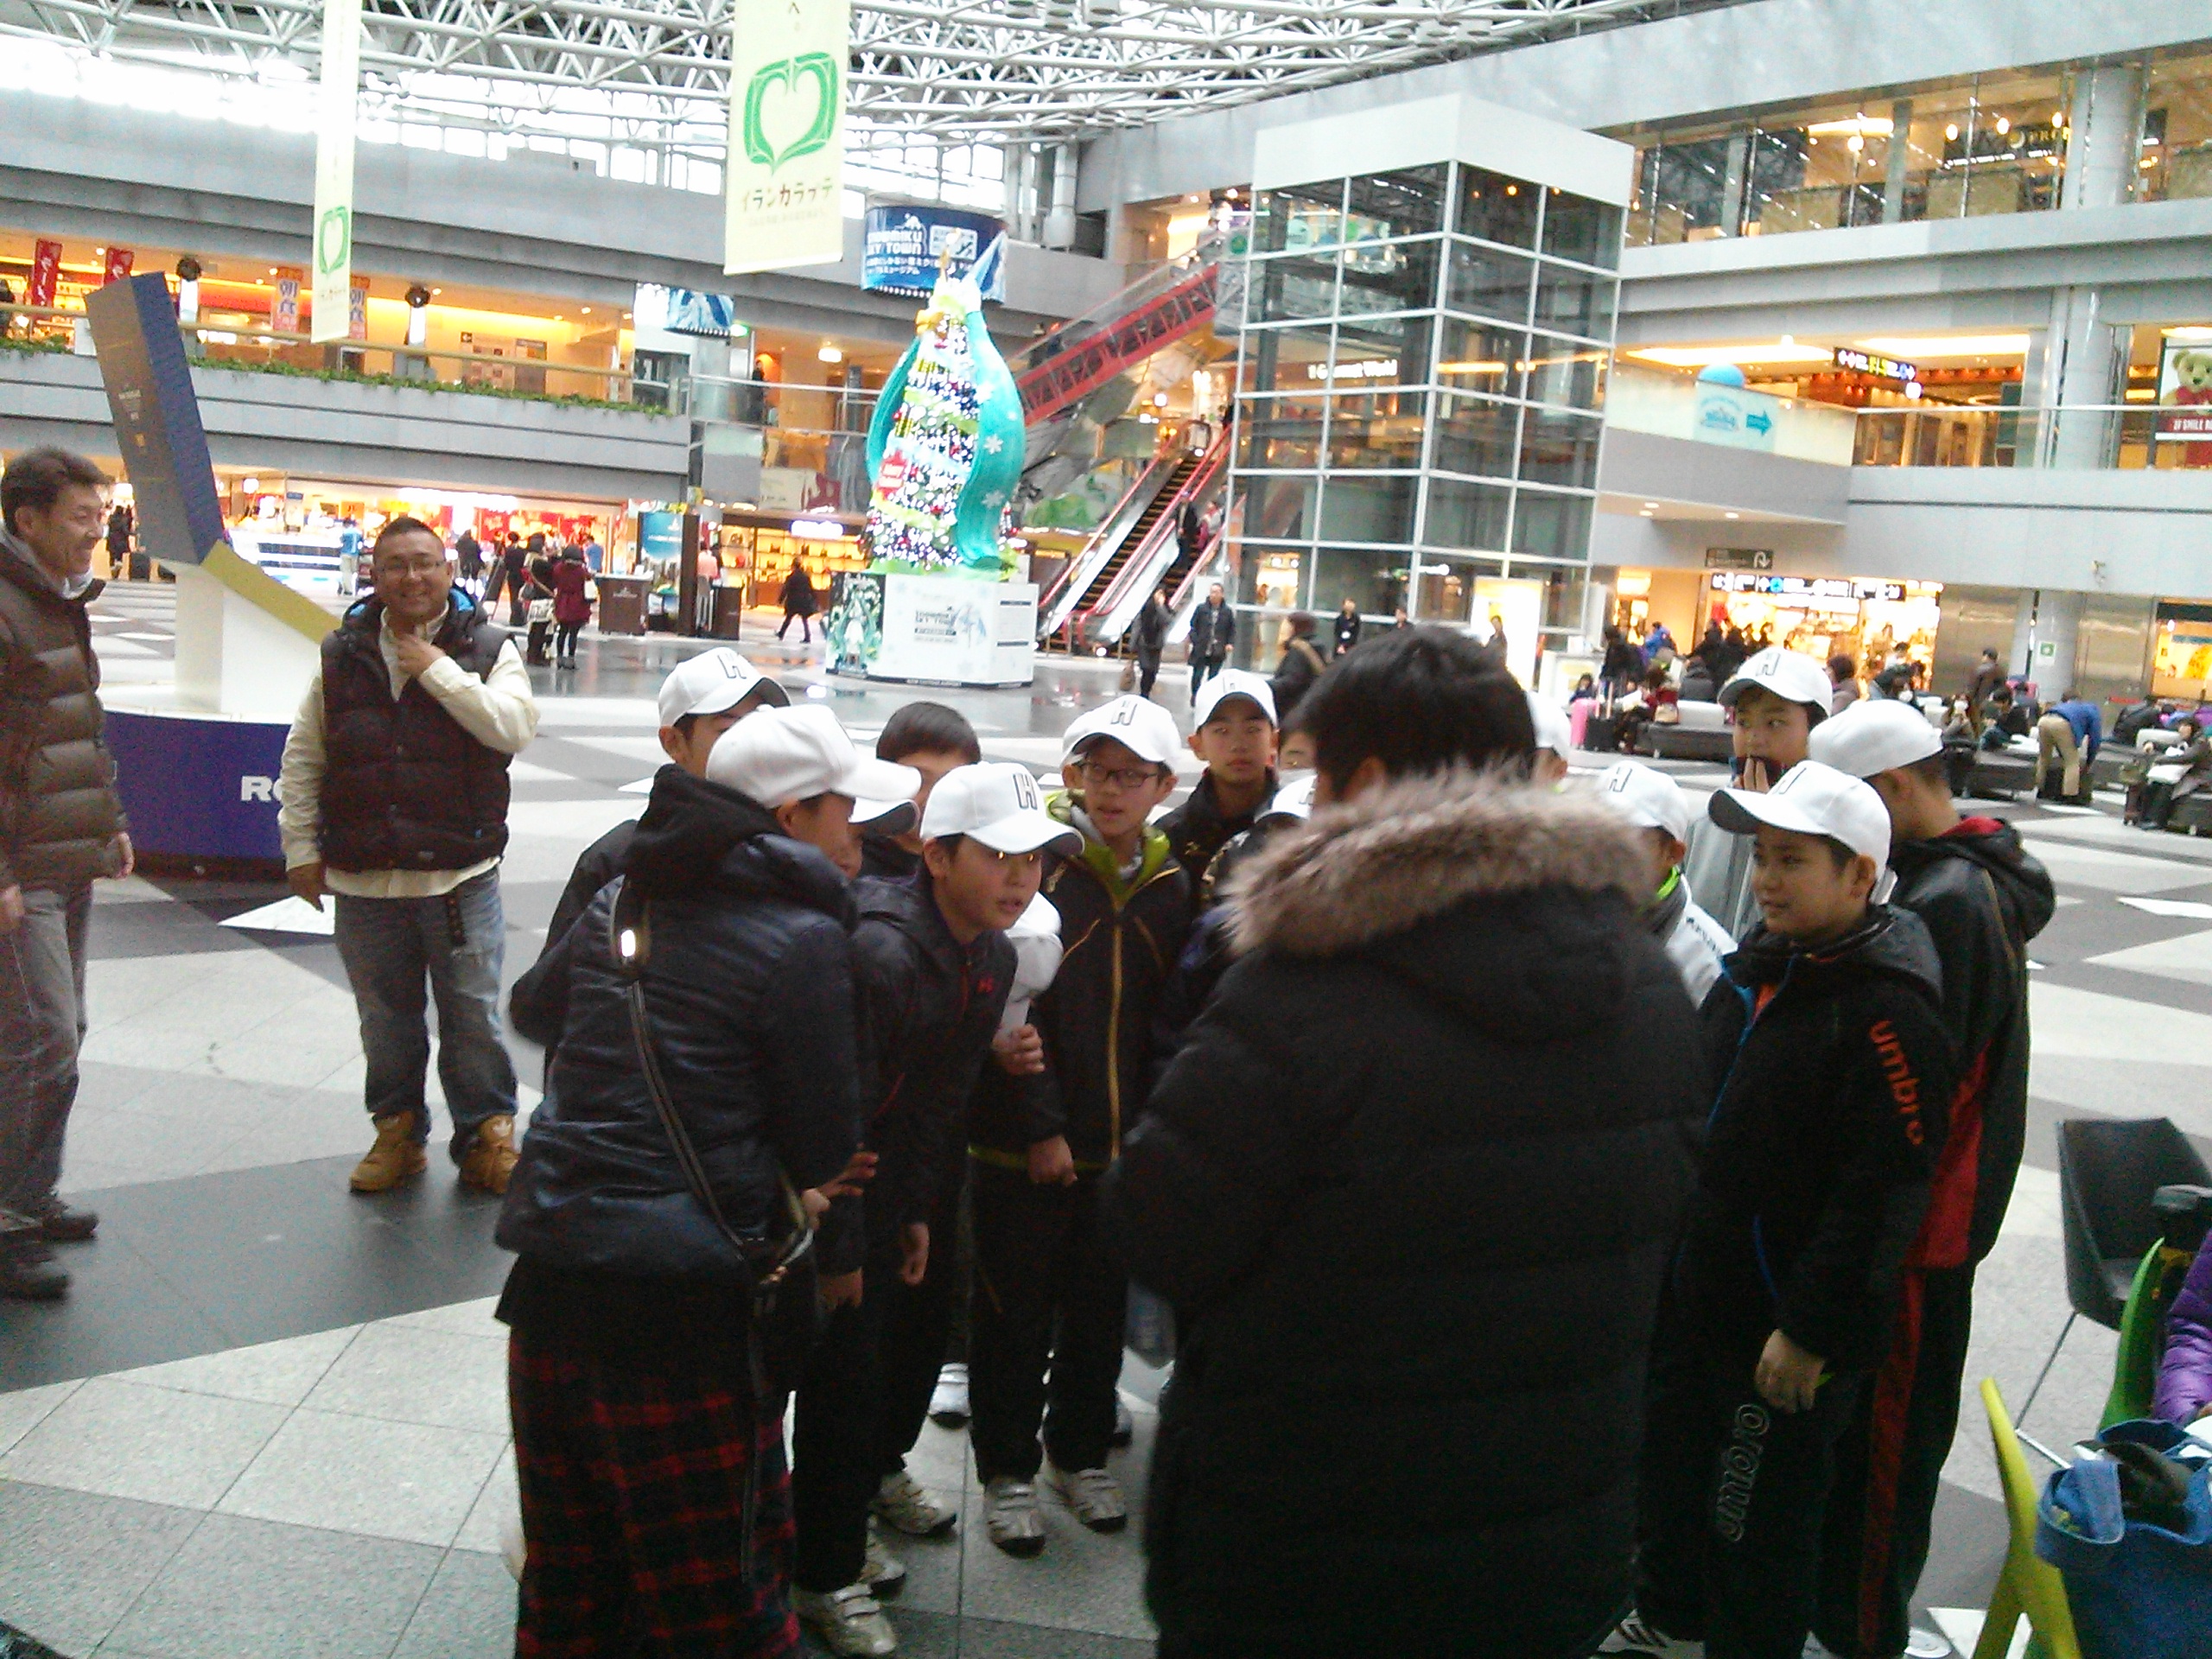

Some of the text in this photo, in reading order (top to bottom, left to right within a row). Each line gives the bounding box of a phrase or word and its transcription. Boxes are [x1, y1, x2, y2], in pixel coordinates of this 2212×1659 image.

[1109, 700, 1138, 727] H
[1012, 772, 1039, 810] H
[1608, 766, 1634, 793] H
[1868, 1019, 1926, 1147] umbro
